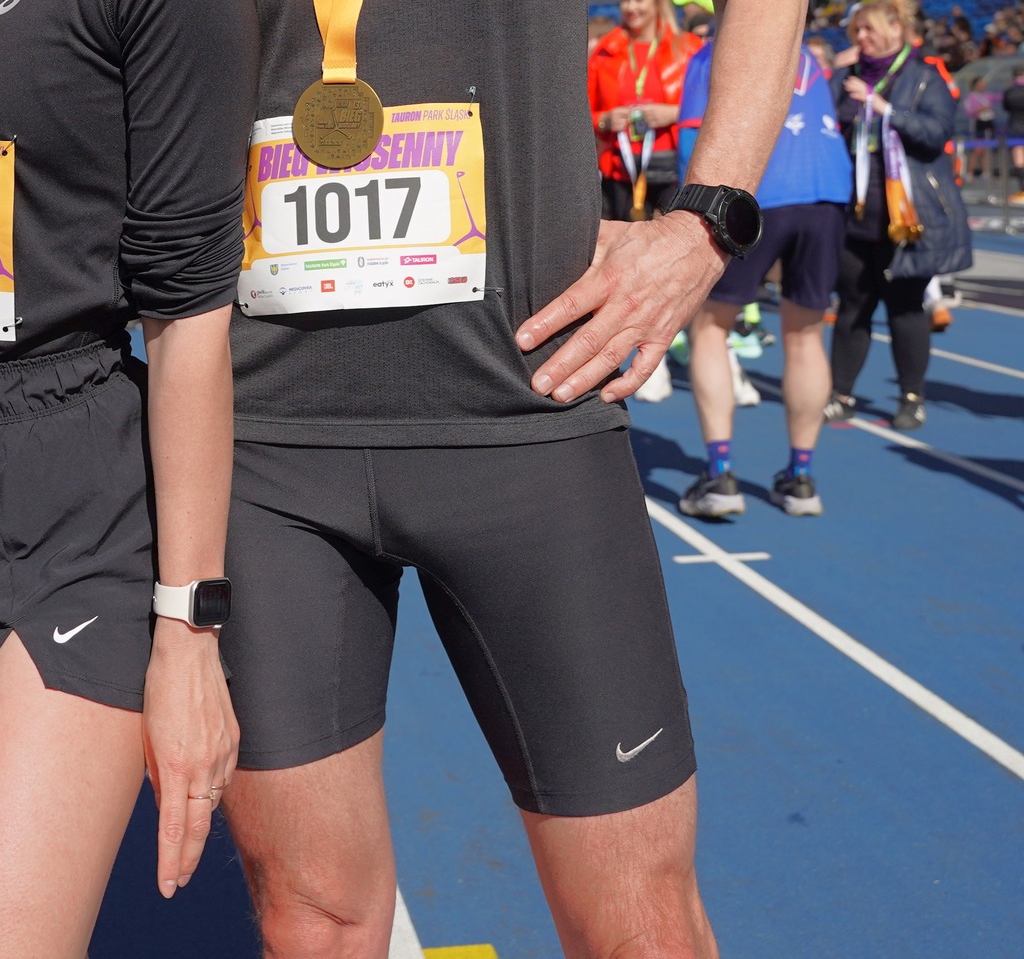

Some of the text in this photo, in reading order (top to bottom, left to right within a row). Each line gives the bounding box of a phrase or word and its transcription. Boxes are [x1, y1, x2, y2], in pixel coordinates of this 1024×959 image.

[391, 111, 422, 123] TAURON
[422, 109, 445, 122] PARK
[284, 177, 422, 246] 1017
[373, 281, 394, 289] eatyx
